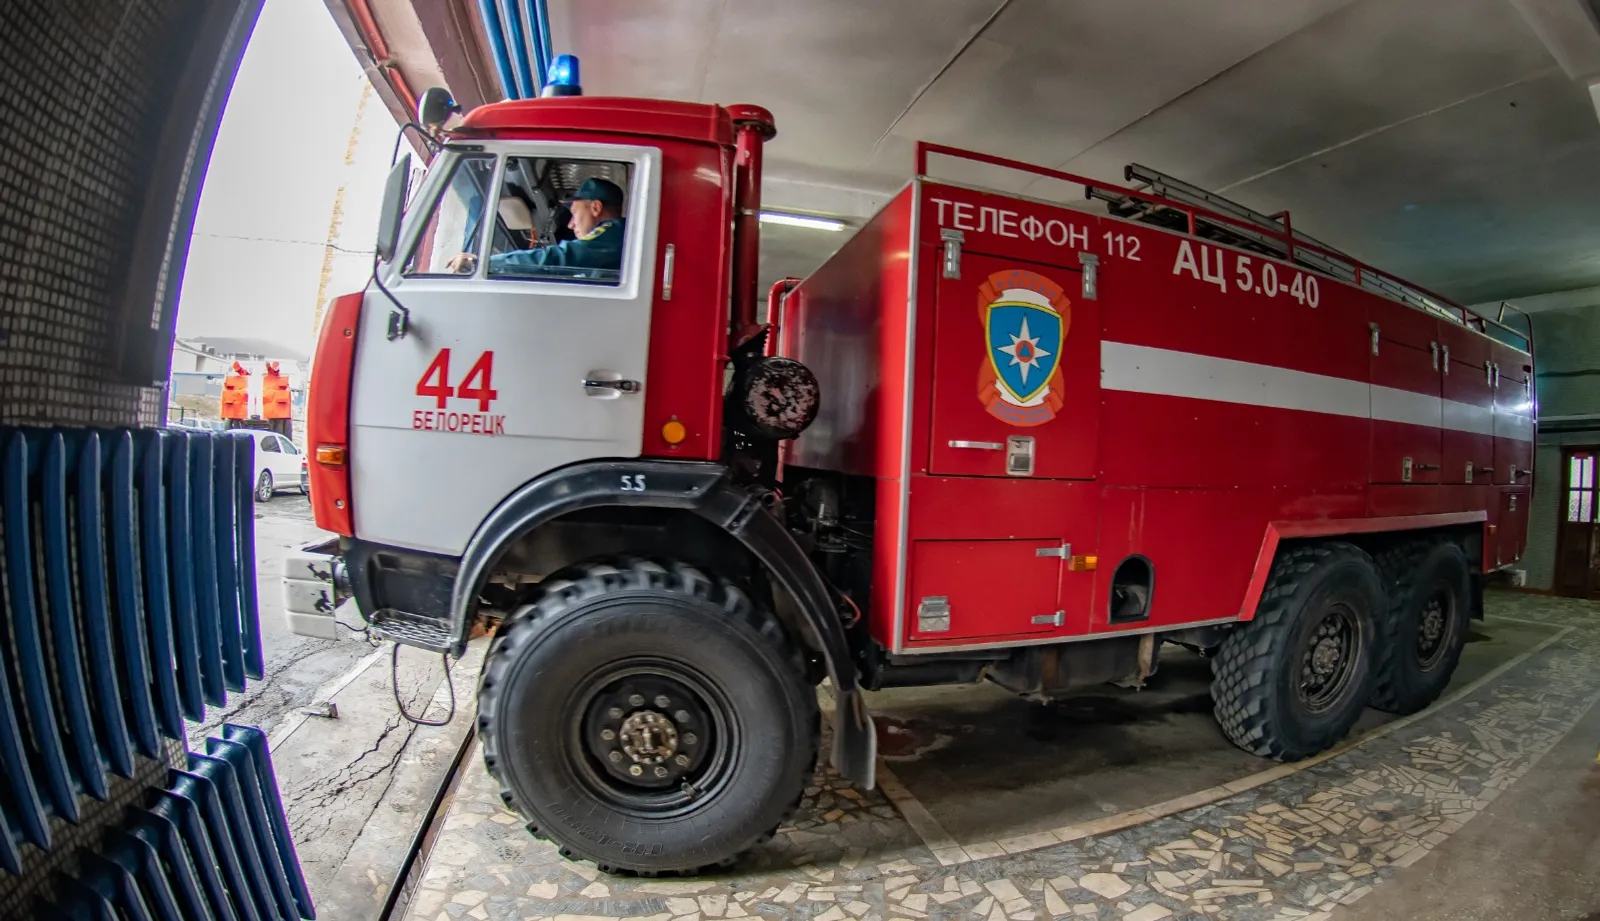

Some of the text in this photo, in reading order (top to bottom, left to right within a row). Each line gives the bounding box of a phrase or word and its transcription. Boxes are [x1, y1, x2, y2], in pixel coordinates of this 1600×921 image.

[930, 198, 1142, 262] ТЕЛЕФОН 112
[1172, 239, 1320, 309] АЦ 5.0-40
[416, 348, 498, 412] 44
[412, 409, 506, 436] БЕЛОРЕЦК
